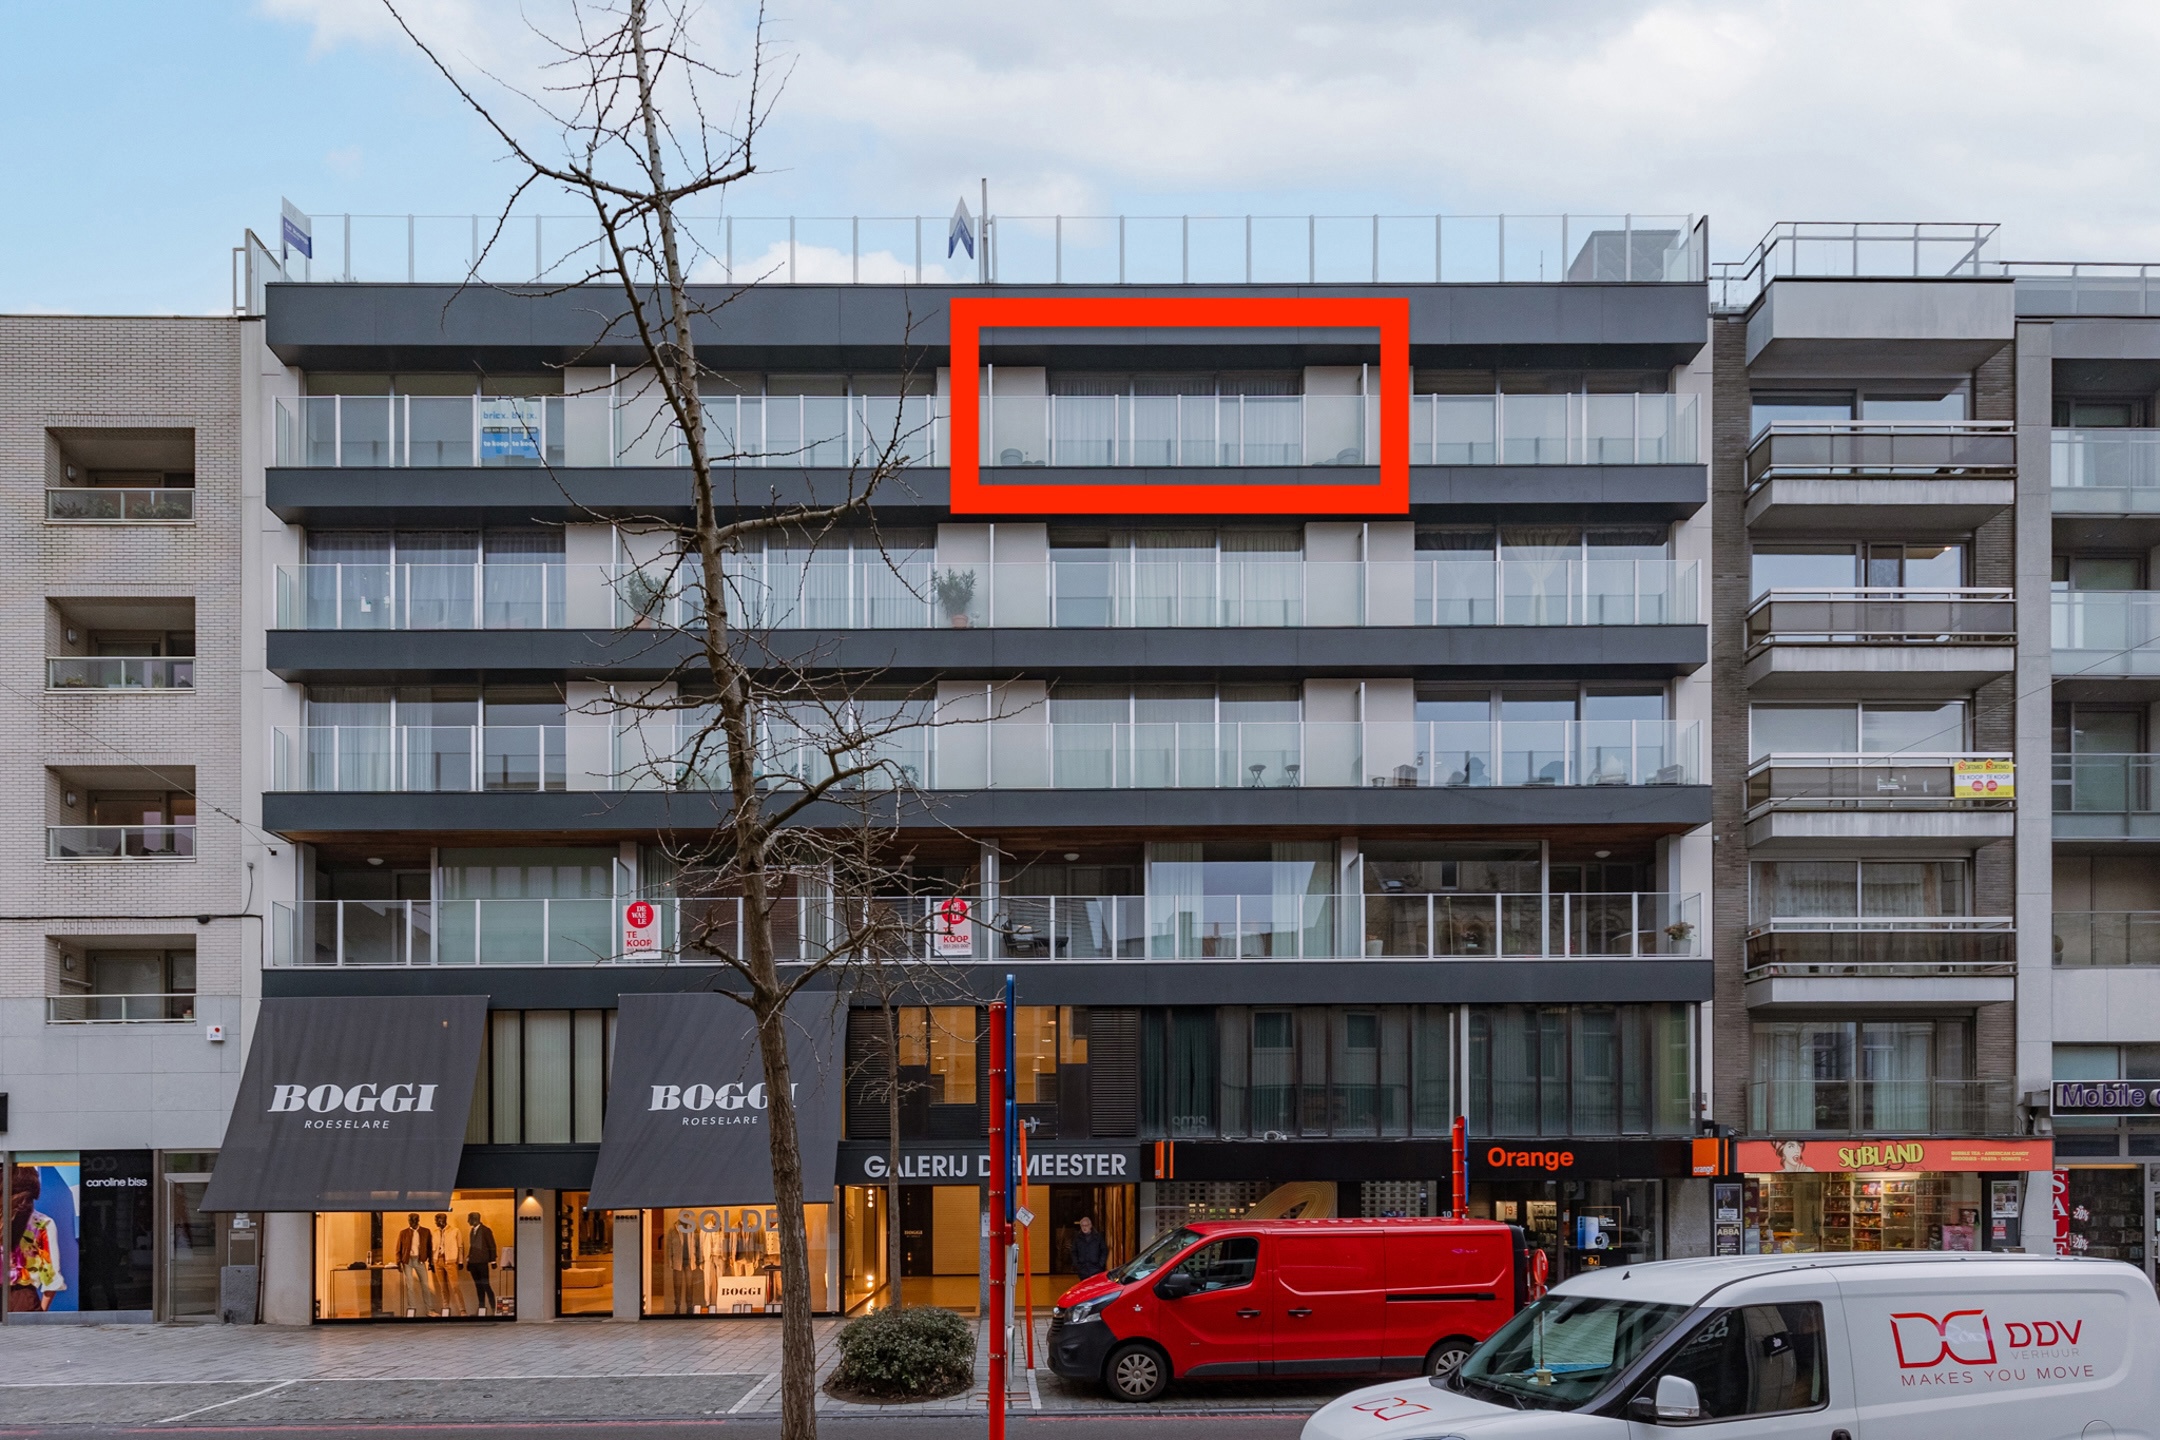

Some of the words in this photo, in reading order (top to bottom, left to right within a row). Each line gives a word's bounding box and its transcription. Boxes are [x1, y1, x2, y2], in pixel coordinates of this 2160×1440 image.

[626, 939, 652, 947] KOOP
[943, 935, 969, 943] KOOP
[267, 1082, 439, 1113] BOGGI
[2057, 1083, 2146, 1107] Mobile
[304, 1119, 391, 1130] ROESELARE
[682, 1115, 759, 1126] ROESELARE
[1487, 1147, 1574, 1171] Orange
[1837, 1142, 1925, 1169] SUBLAND
[86, 1177, 126, 1187] caroline
[127, 1177, 148, 1187] biss
[1717, 1228, 1740, 1236] ABBA
[721, 1287, 762, 1296] BOGGI
[2004, 1319, 2083, 1348] DDV
[2010, 1347, 2080, 1360] VERHUUR
[1901, 1370, 1973, 1387] MAKES
[1983, 1368, 2027, 1382] YOU
[2036, 1364, 2095, 1380] MOVE
